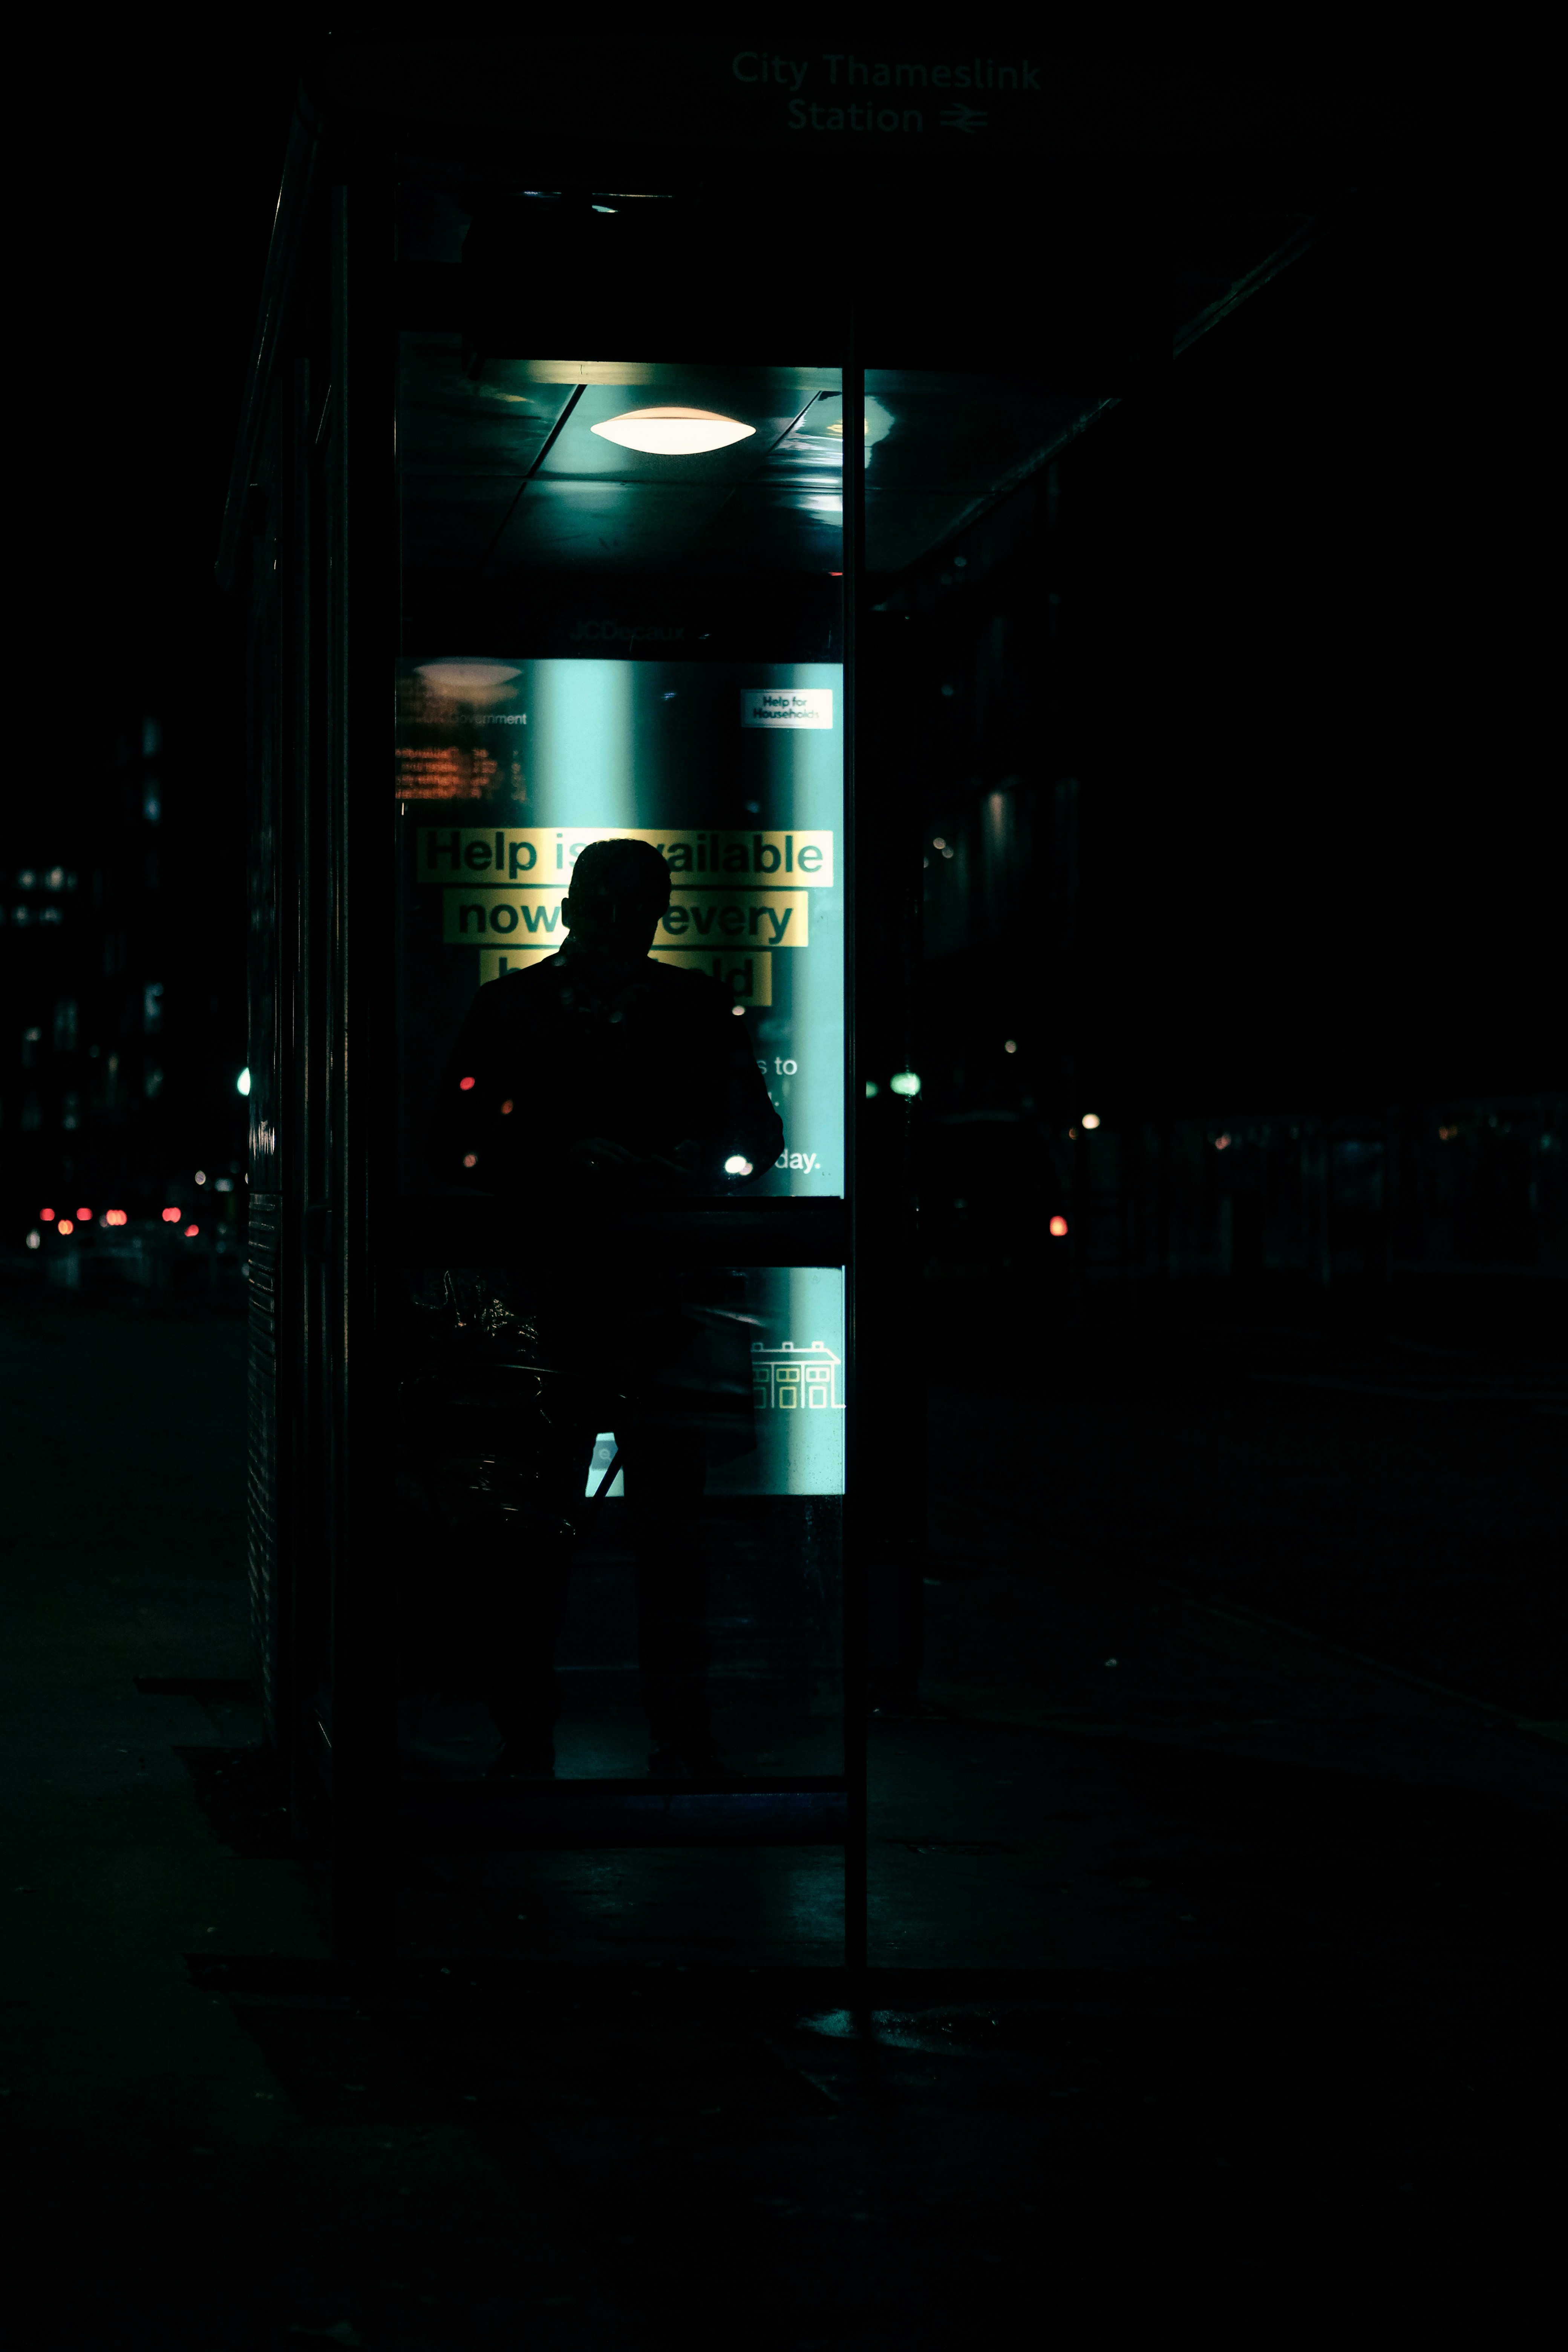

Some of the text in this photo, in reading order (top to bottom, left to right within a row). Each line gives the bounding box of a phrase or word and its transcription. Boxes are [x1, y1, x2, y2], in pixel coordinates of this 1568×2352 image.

[732, 51, 1041, 91] City Thameslink
[787, 98, 923, 133] Station
[570, 620, 684, 640] JCDecaux
[754, 708, 819, 718] Households
[763, 696, 807, 709] Help for
[427, 831, 537, 879] Help
[657, 834, 823, 874] ailable
[459, 903, 792, 944] now every
[775, 1057, 797, 1075] to
